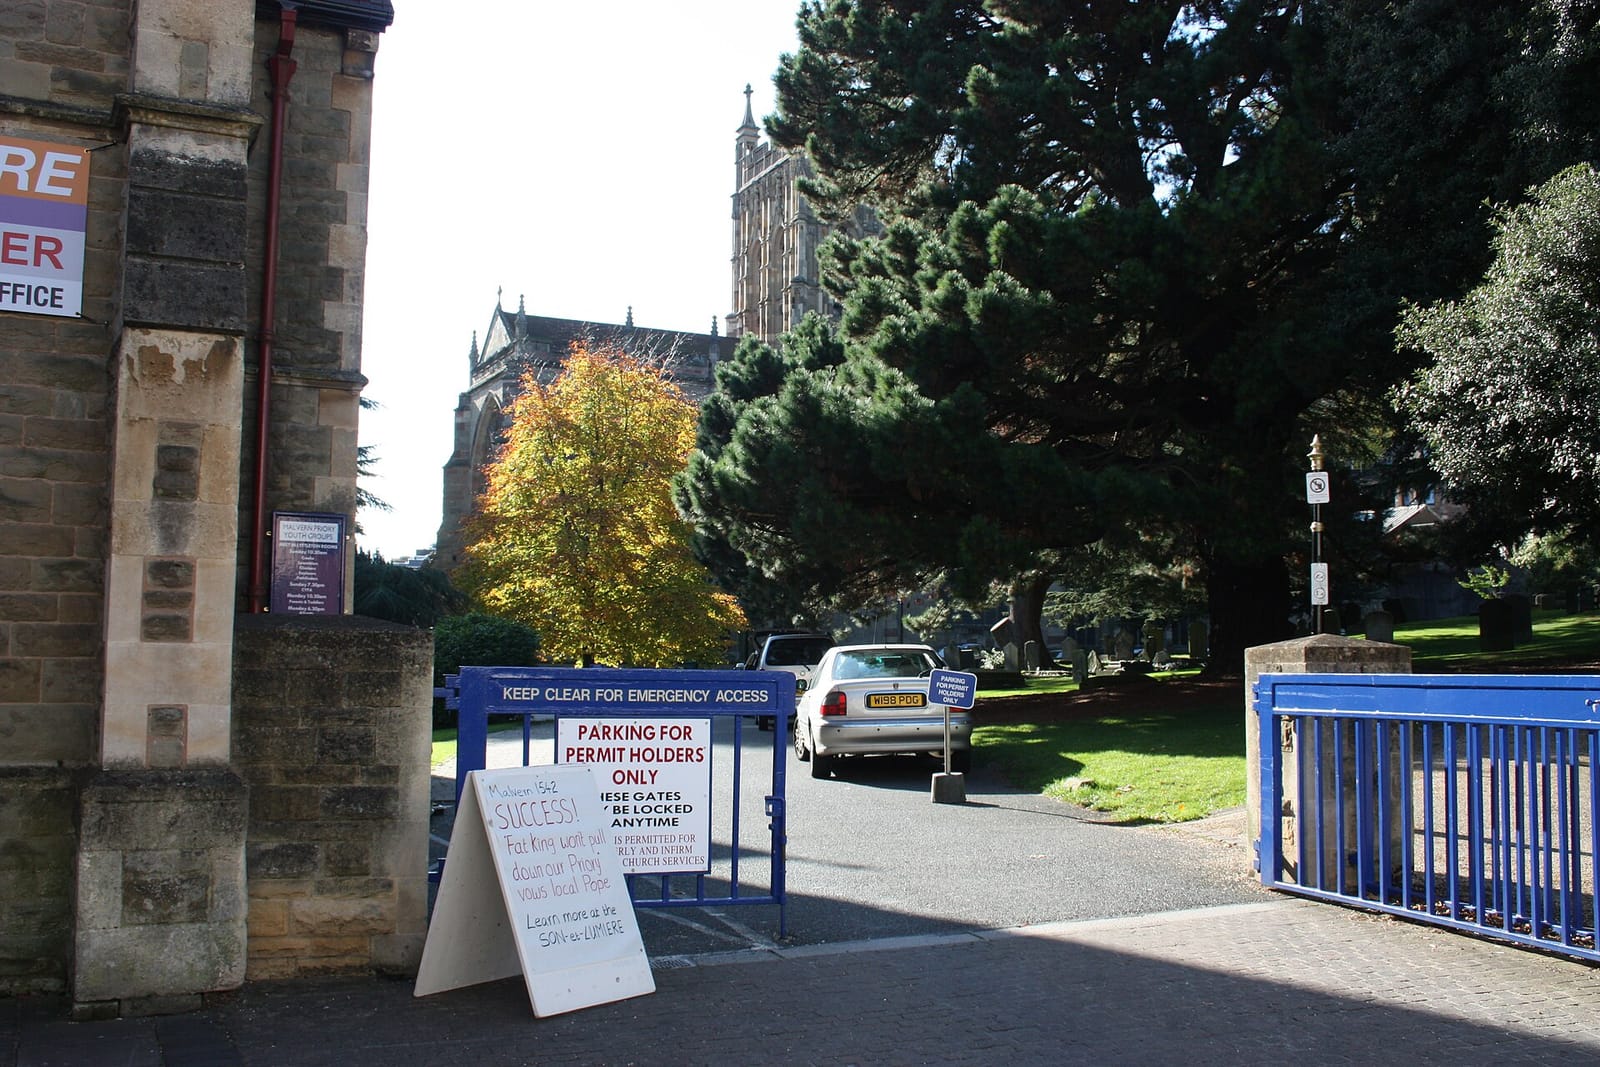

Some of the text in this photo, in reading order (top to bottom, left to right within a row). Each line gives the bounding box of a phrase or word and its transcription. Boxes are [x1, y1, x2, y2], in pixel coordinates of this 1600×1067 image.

[0, 143, 82, 197] RE
[1, 231, 64, 270] ER
[284, 531, 333, 540] YOUTH GROUPS
[941, 675, 966, 684] PARKING
[503, 687, 769, 702] KEEP CLEAR FOR EMERGENCY ACCESS
[938, 689, 965, 698] HOLDERS
[948, 683, 969, 692] PERMIT
[874, 696, 896, 705] W198
[578, 725, 693, 741] PARKING FOR
[566, 747, 705, 763] PERMIT HOLDERS
[612, 769, 659, 785] ONLY
[534, 780, 559, 795] 1542
[633, 792, 681, 801] GATES
[494, 797, 580, 830] SUCCESS!
[613, 805, 630, 814] BE
[633, 804, 693, 814] LOCKED
[610, 817, 679, 827] ANYTIME
[504, 834, 529, 856] Fat
[588, 828, 607, 854] pull
[614, 834, 696, 845] IS PERMITTED FOR
[616, 845, 693, 856] RLY AND INFIRM
[512, 853, 602, 881] down our Priory
[622, 856, 705, 867] CHURCH SERVICES
[517, 874, 611, 902] vows local Pope
[527, 903, 617, 929] Learn more at the
